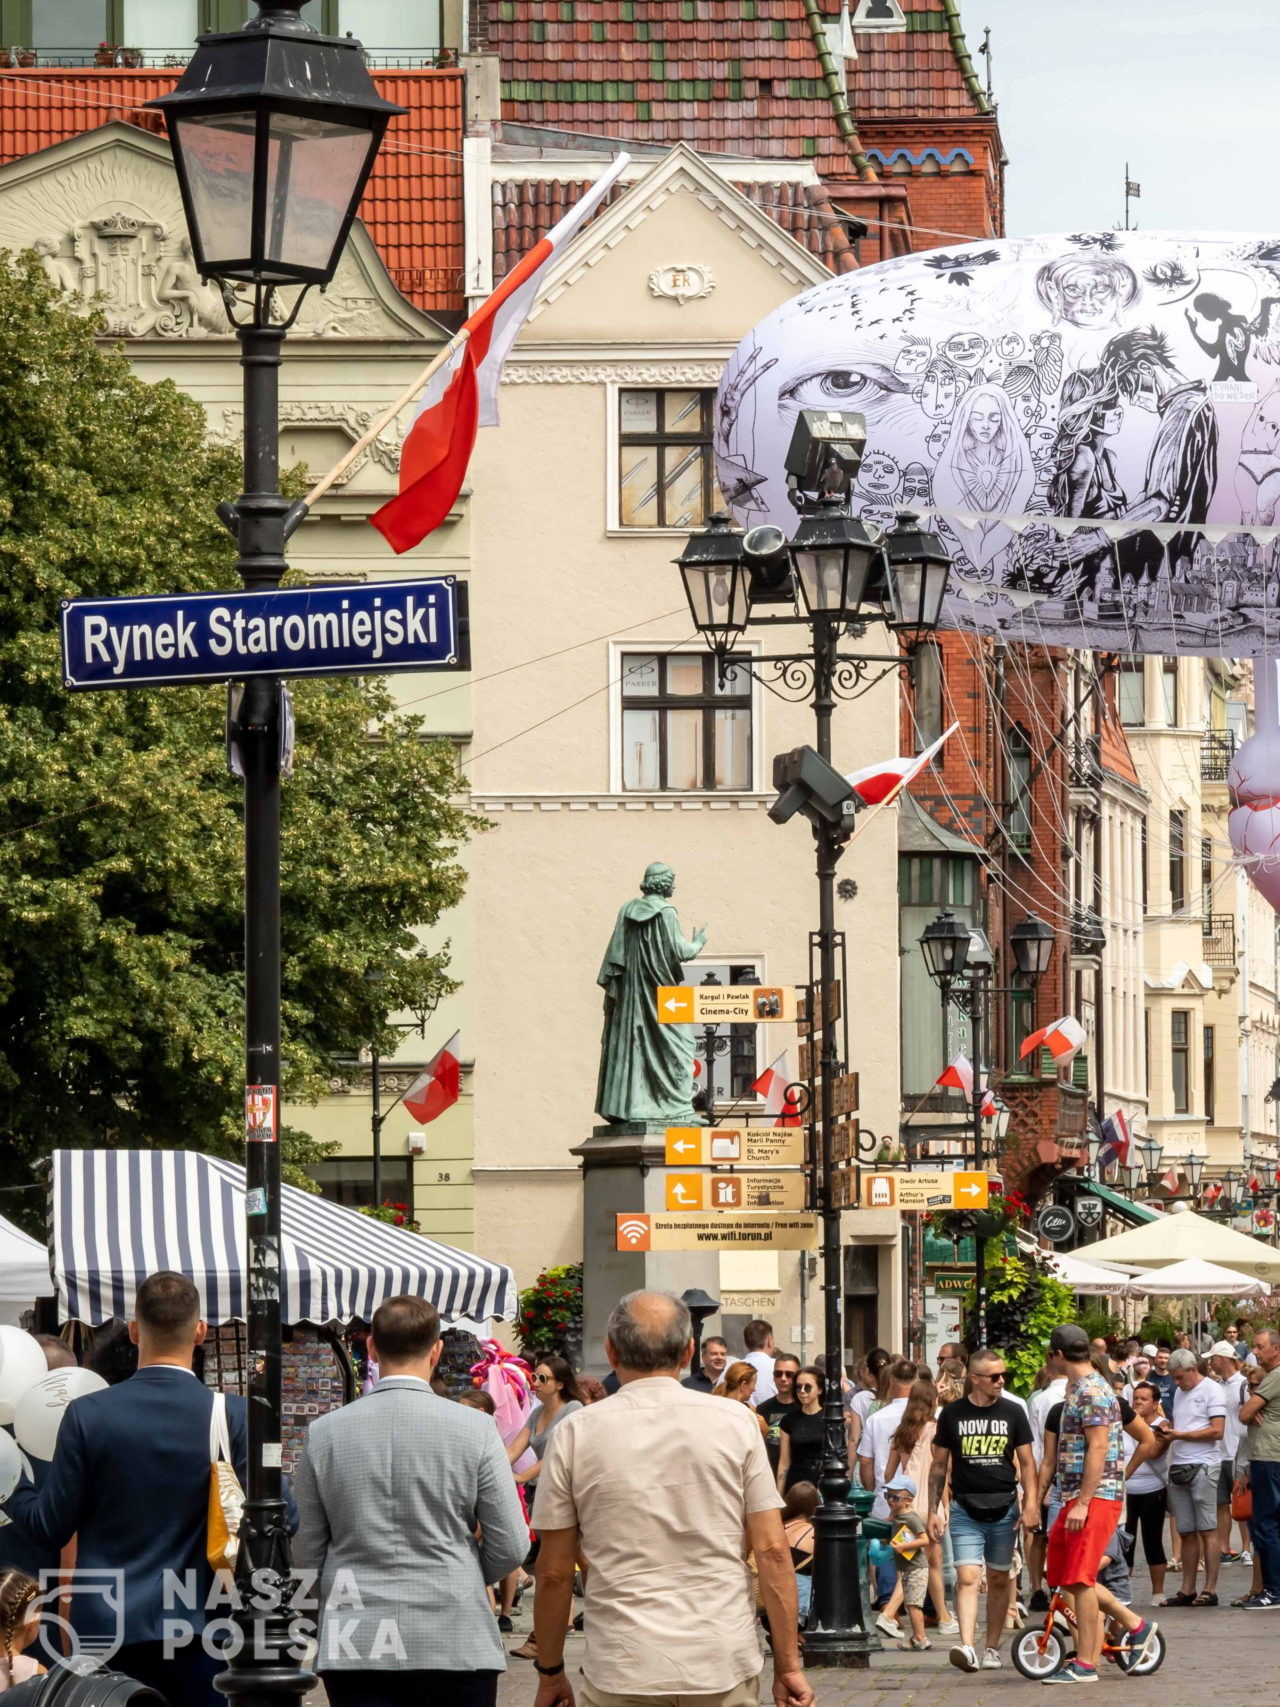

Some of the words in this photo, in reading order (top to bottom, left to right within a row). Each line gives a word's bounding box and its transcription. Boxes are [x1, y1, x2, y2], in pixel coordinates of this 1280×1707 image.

[83, 610, 198, 674] Rynek
[208, 594, 438, 659] Staromiejski
[700, 1007, 749, 1016] Cinema-City
[437, 1172, 451, 1183] 38
[697, 1231, 773, 1241] www.wifi.torun.pl
[723, 1297, 775, 1307] TASCHEN
[958, 1420, 988, 1436] NOW
[990, 1420, 1009, 1435] OR
[961, 1435, 1009, 1456] NEVER
